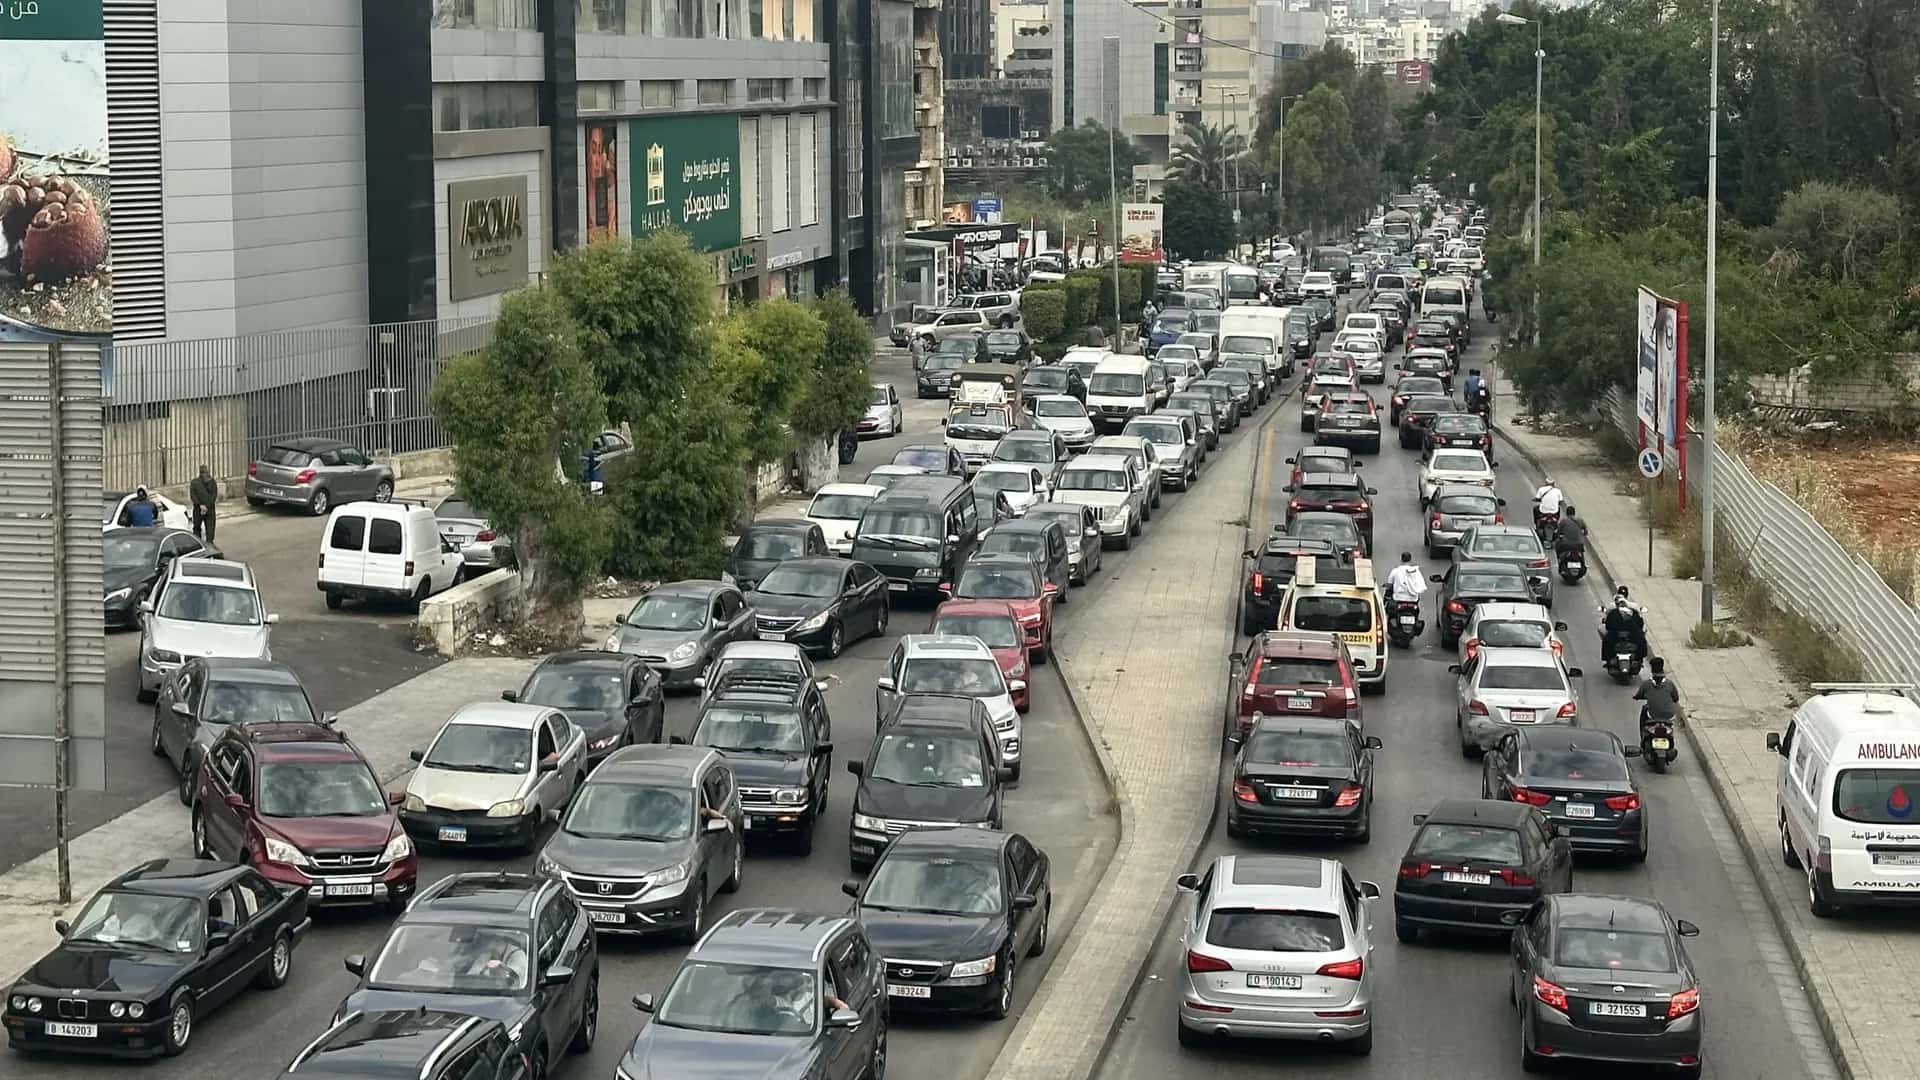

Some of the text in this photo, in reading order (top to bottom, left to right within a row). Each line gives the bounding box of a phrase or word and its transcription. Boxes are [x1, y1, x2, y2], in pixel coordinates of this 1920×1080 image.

[683, 177, 730, 223] أحلى بوجودكن
[641, 209, 672, 232] HALLAB
[1597, 1003, 1640, 1015] B 321555
[51, 1024, 92, 1036] B 143203
